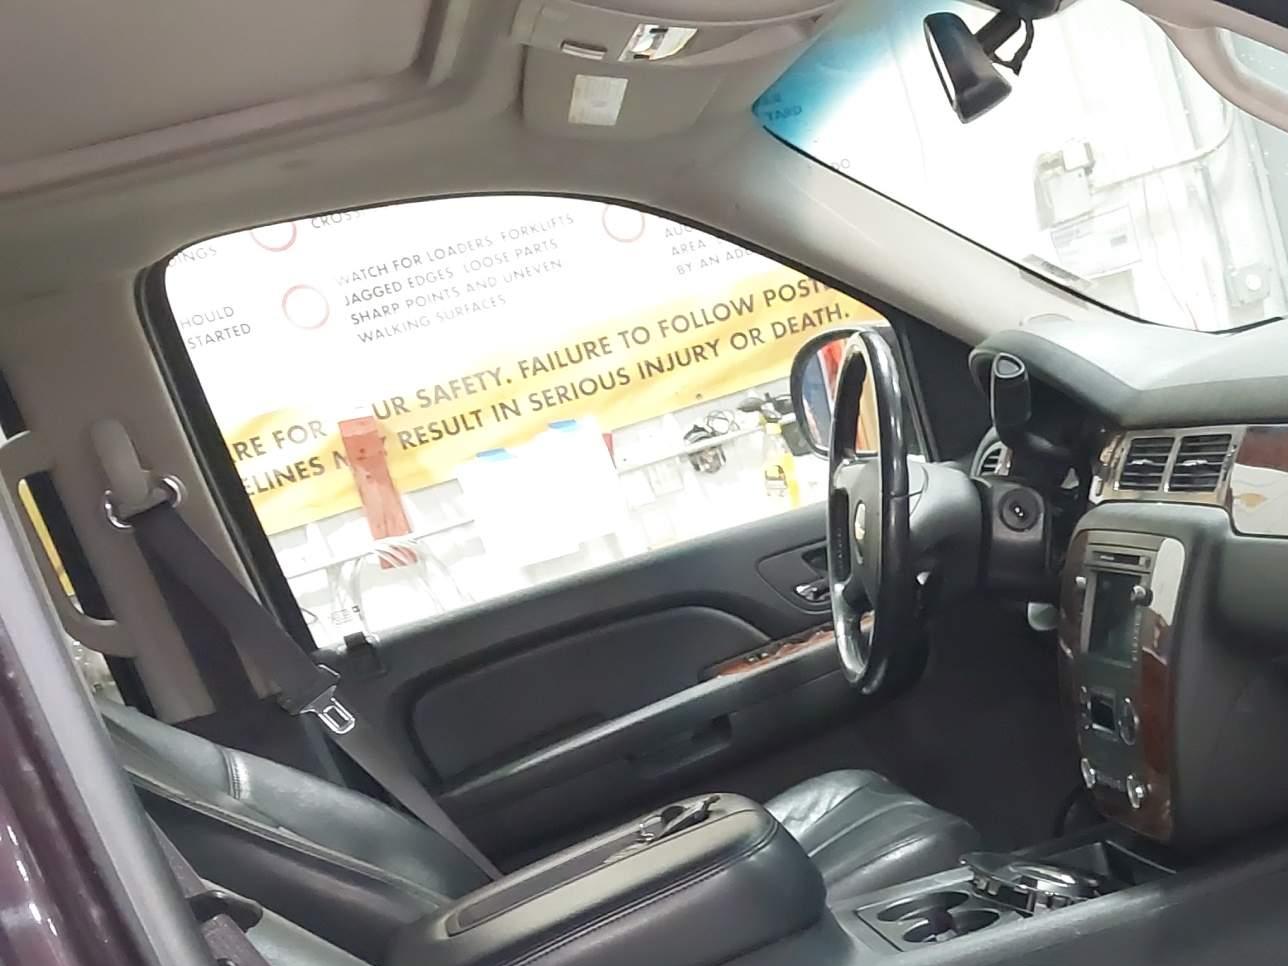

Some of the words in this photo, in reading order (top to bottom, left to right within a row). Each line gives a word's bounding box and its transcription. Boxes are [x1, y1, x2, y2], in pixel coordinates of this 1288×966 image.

[336, 264, 388, 286] WATCH
[392, 254, 422, 272] FOR
[671, 239, 707, 256] AREA
[676, 262, 693, 275] BY
[700, 255, 721, 269] AN
[344, 281, 402, 306] JAGGED
[514, 238, 558, 258] PARTS
[350, 302, 400, 325] SHARP
[405, 286, 460, 309] POINTS
[466, 276, 497, 294] AND
[503, 258, 563, 284] UNEVEN
[187, 323, 252, 350] STARTED
[356, 315, 431, 343] WALKING
[436, 294, 506, 322] SURFACES
[416, 366, 513, 408] SAFETY.
[518, 337, 613, 379] FAILURE
[617, 326, 651, 349] TO
[658, 294, 755, 338] FOLLOW
[397, 410, 485, 450] RESULT
[491, 399, 522, 422] IN
[528, 368, 632, 412] SERIOUS
[639, 338, 721, 380] INJURY
[730, 327, 765, 351] OR
[771, 302, 850, 339] DEATH.
[231, 436, 267, 463] RE
[272, 420, 329, 449] FOR
